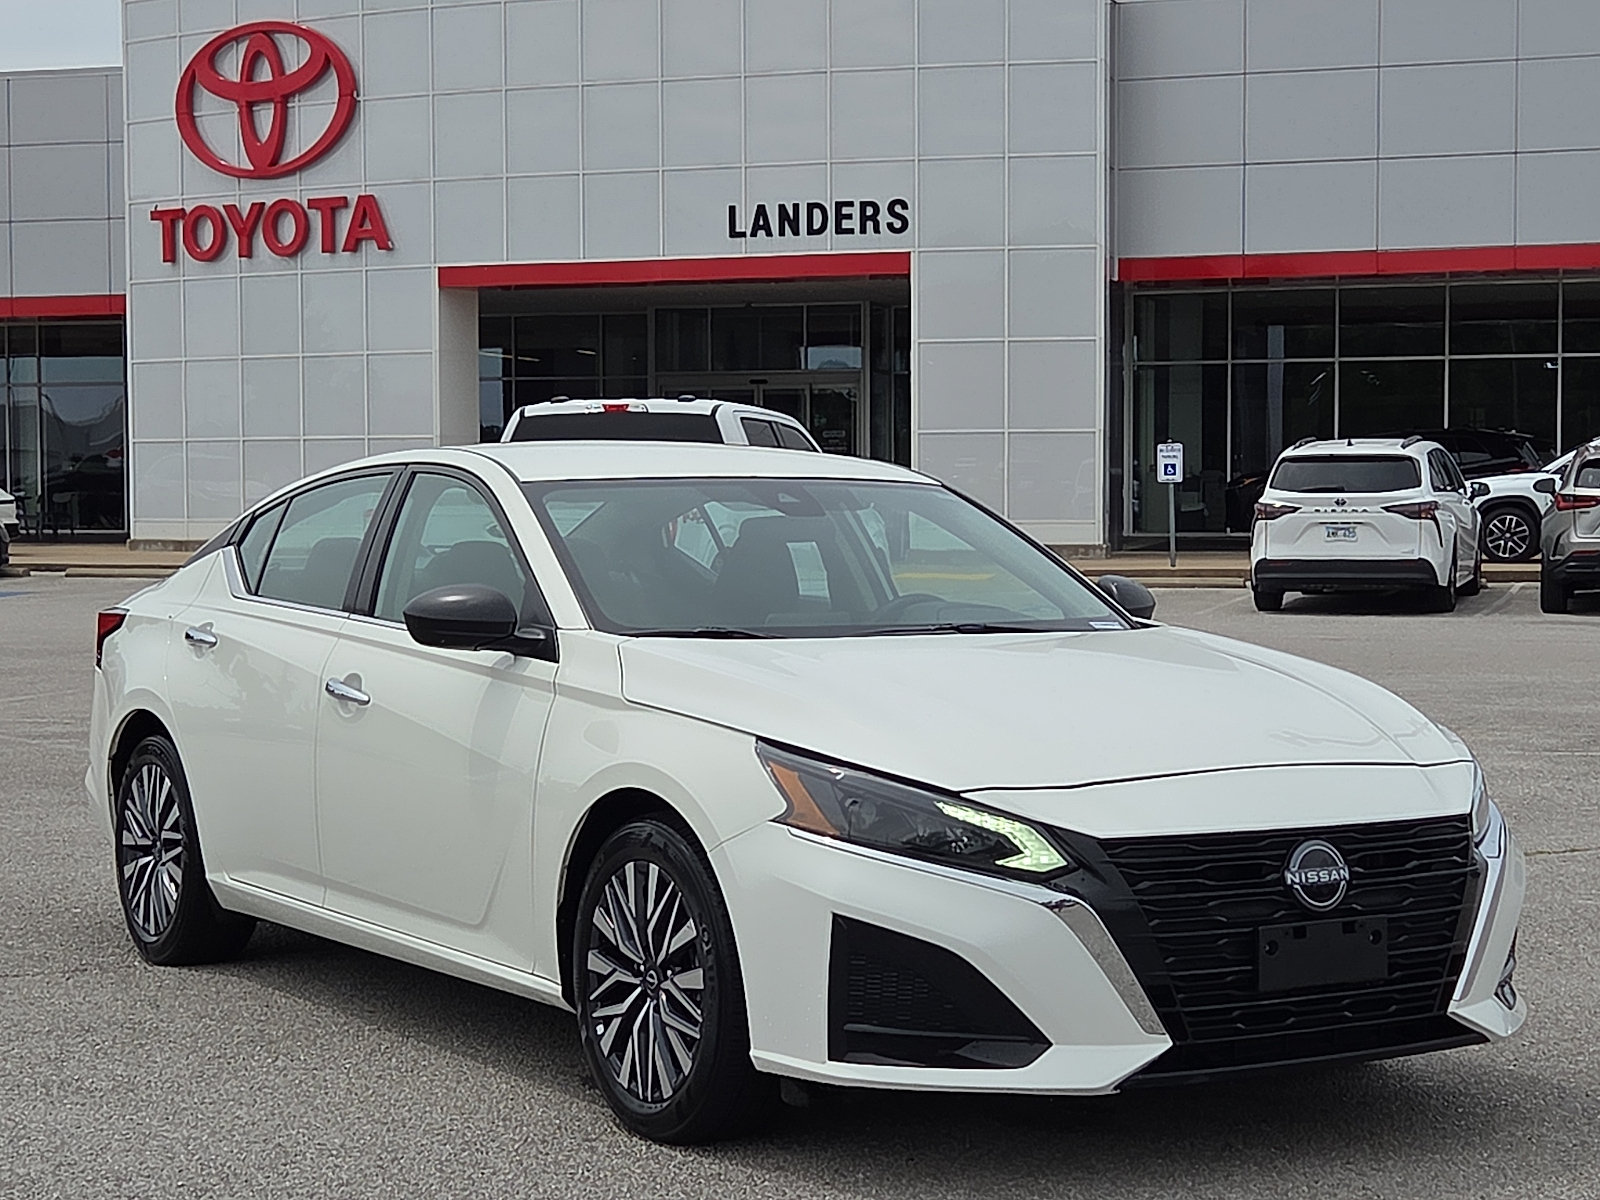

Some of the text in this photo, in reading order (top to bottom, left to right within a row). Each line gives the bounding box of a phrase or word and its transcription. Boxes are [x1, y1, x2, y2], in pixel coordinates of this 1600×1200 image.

[150, 194, 393, 263] TOYOTA
[728, 198, 909, 238] LANDERS
[1285, 865, 1349, 886] NISSAN
